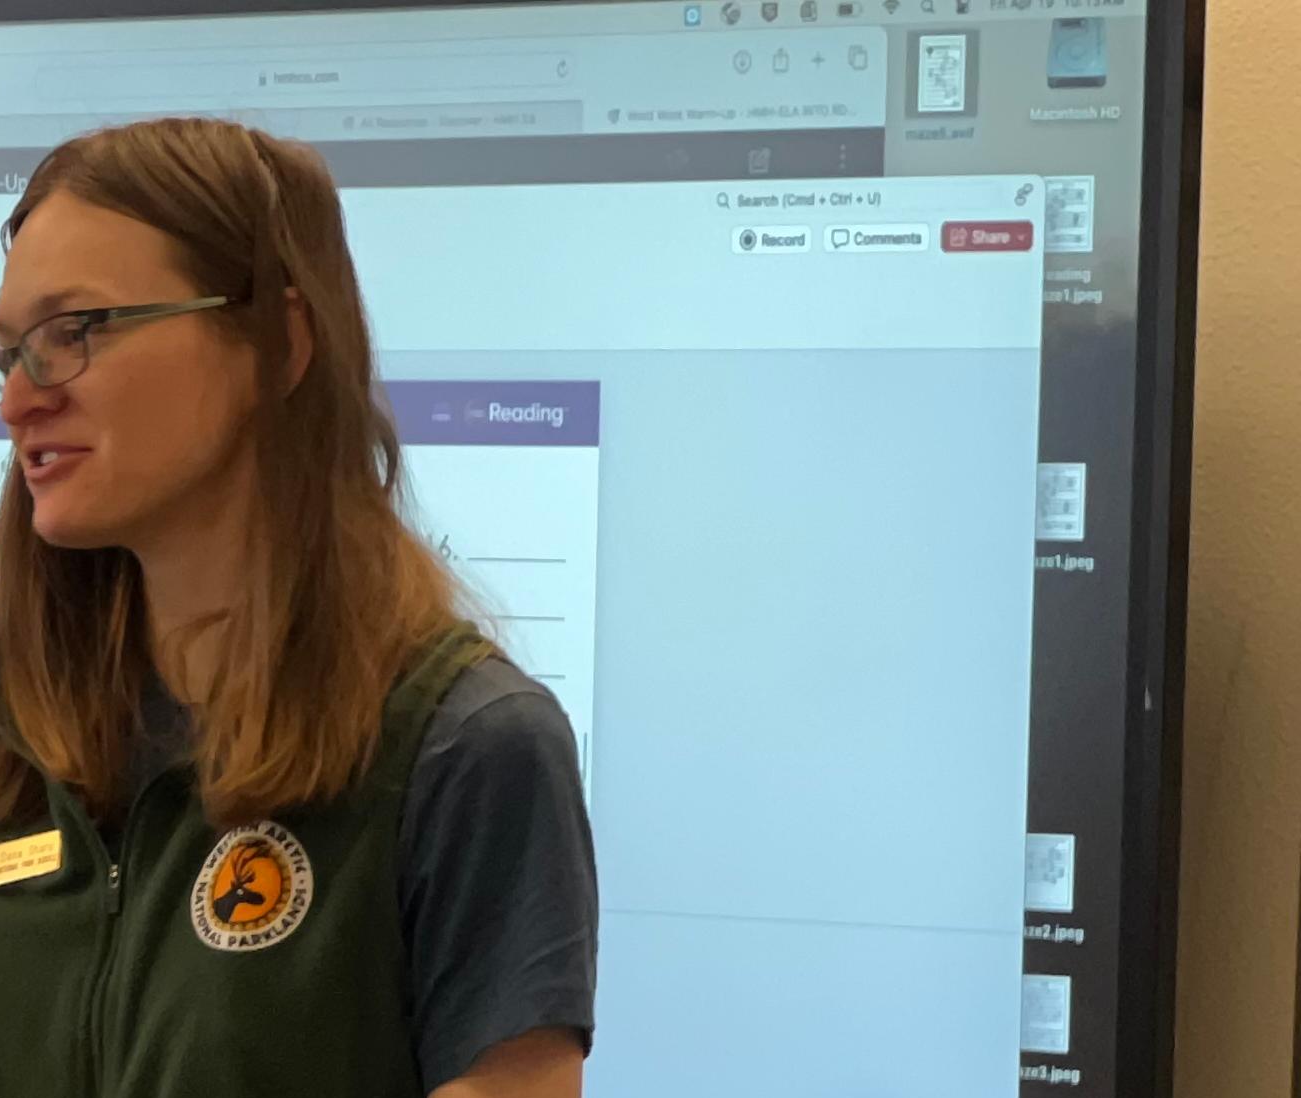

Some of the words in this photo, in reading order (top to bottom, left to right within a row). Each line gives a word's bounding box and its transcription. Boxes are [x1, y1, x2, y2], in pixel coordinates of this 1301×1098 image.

[1030, 107, 1097, 121] Macintosh
[1100, 106, 1121, 120] HD
[737, 194, 779, 208] Search
[829, 191, 853, 207] Ctrl
[761, 232, 806, 248] Record
[853, 231, 923, 248] Comments
[971, 230, 1011, 246] Share
[488, 401, 565, 428] Reading
[195, 881, 222, 946] NATIONAL
